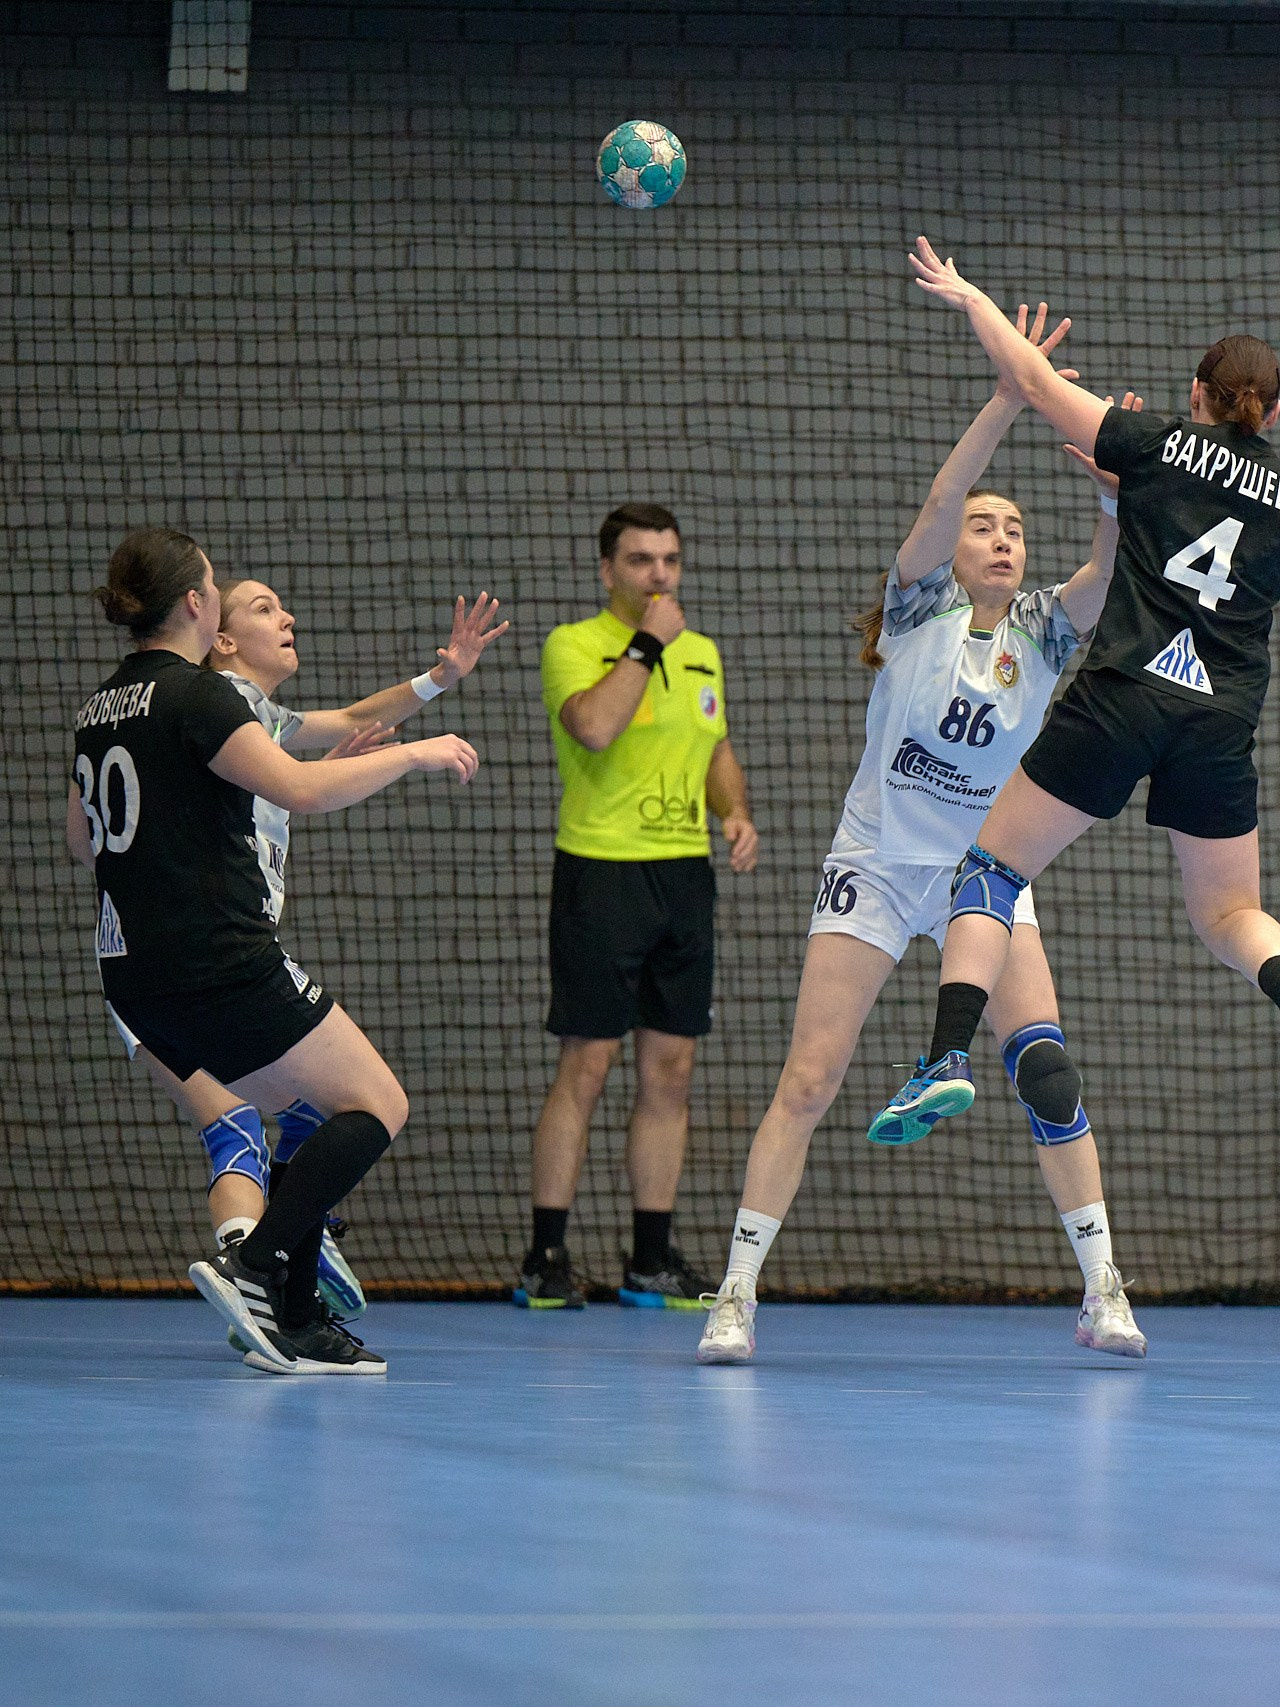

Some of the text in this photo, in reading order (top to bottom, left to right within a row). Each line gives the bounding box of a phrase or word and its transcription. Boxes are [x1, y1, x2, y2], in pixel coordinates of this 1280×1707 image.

[1163, 516, 1245, 612] 4
[939, 696, 997, 748] 86
[76, 745, 141, 858] 30
[912, 784, 961, 806] КОМПАНИЙ
[816, 867, 861, 916] 86
[735, 1235, 760, 1247] erima
[1077, 1228, 1104, 1240] erima
